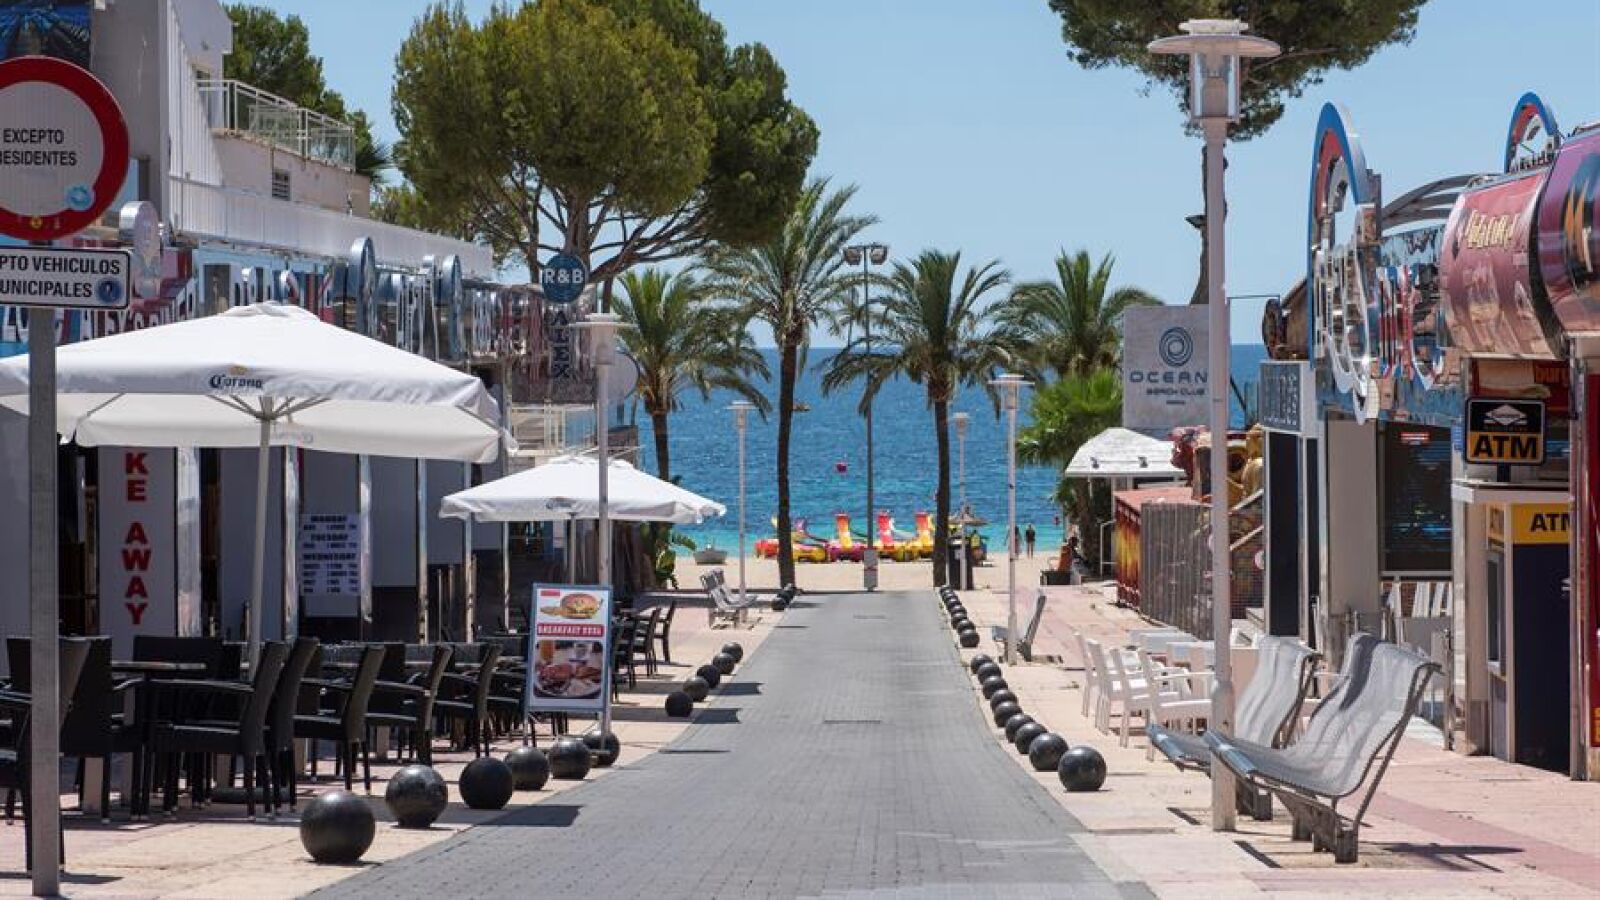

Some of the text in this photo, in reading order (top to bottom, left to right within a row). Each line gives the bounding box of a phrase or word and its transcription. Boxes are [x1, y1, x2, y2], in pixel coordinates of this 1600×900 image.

[3, 130, 65, 144] EXCEPTO
[0, 150, 78, 166] ESIDENTES
[32, 257, 120, 275] VEHICULOS
[544, 268, 584, 285] R&B
[209, 374, 263, 390] Corona
[1130, 371, 1208, 383] OCEAN
[1180, 388, 1205, 396] CLUB
[1472, 434, 1538, 460] ATM
[121, 521, 152, 625] AWAY
